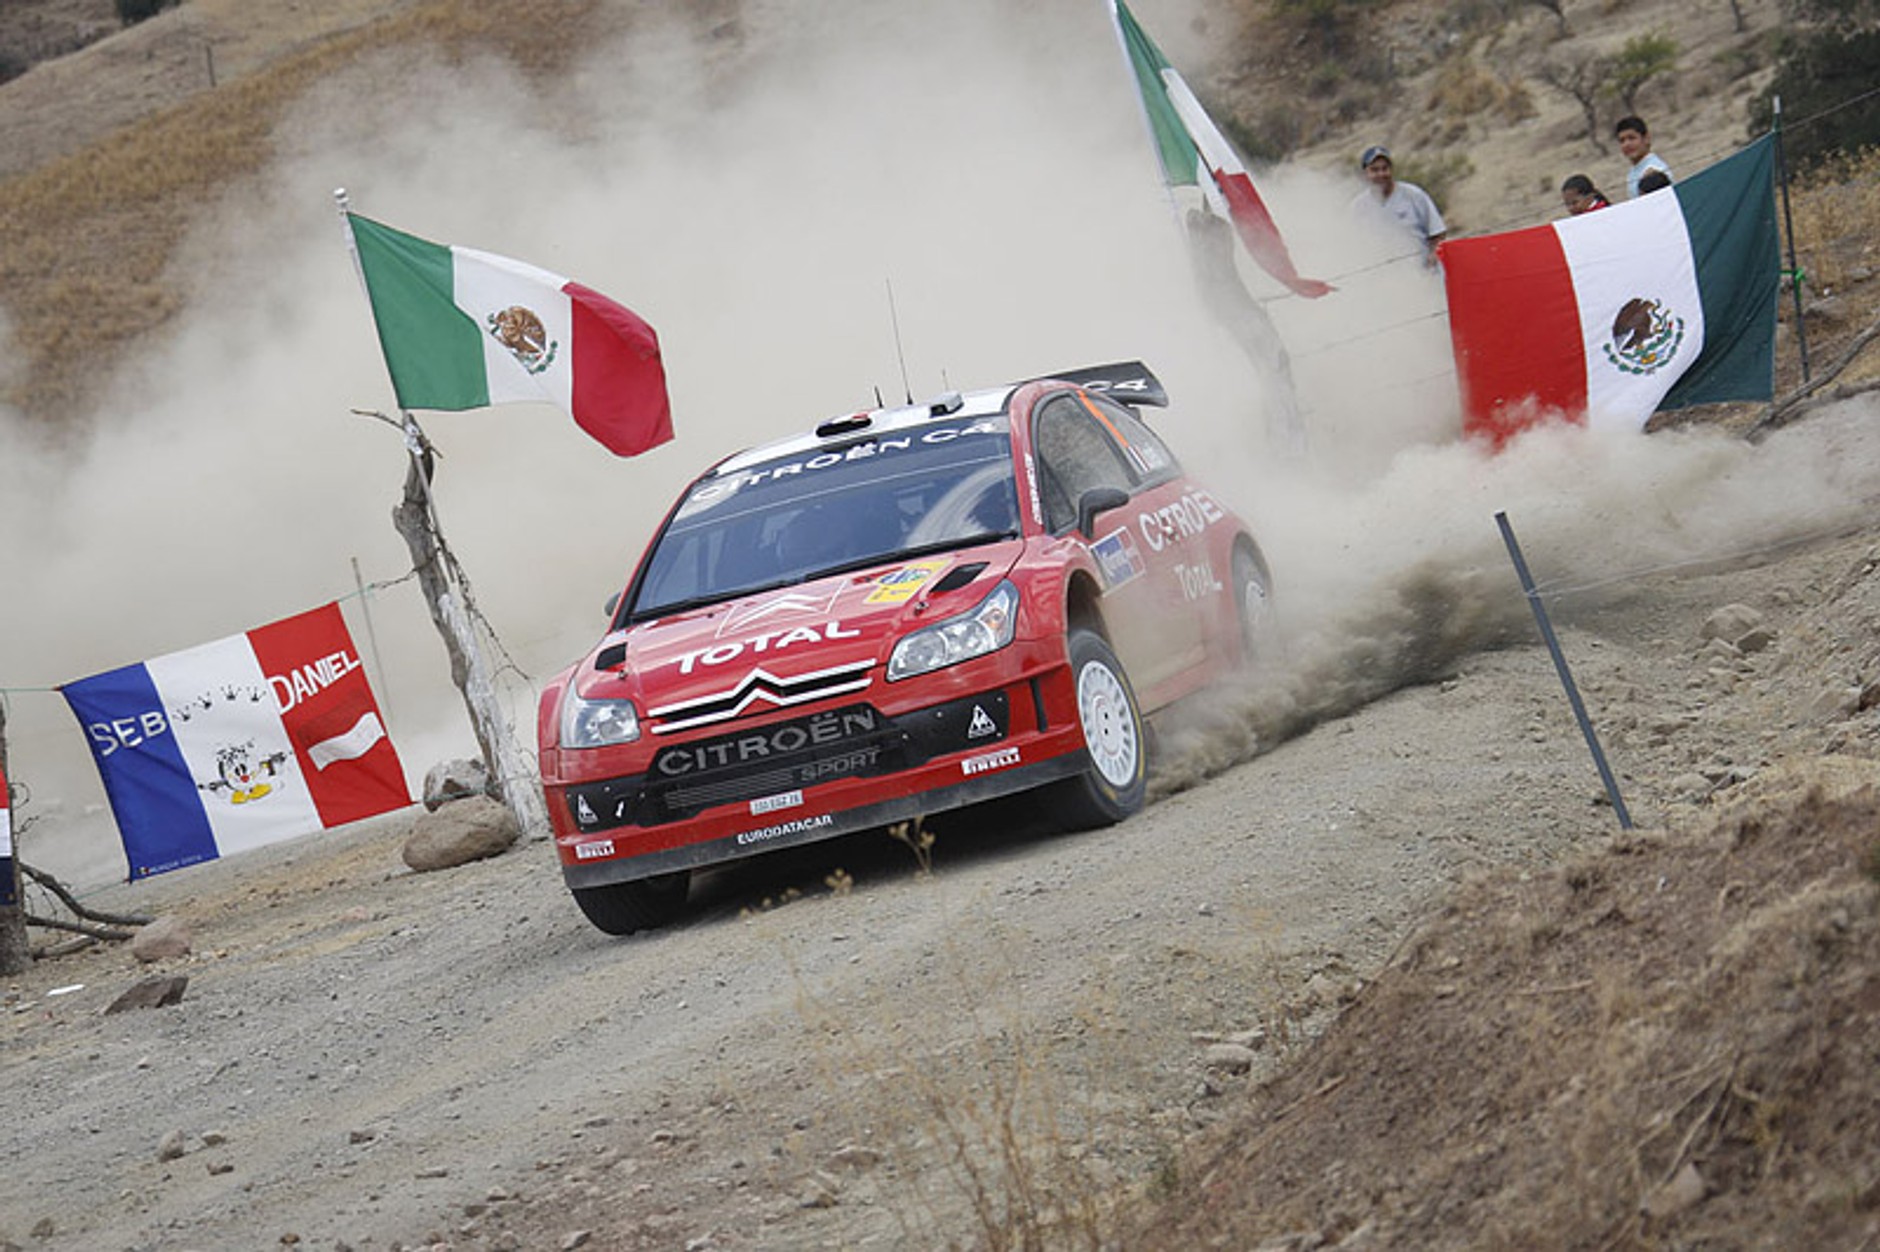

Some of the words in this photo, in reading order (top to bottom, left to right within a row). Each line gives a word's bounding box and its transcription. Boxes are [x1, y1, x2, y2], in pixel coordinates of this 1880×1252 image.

[1082, 378, 1148, 392] C4
[921, 422, 997, 444] C4
[674, 621, 860, 674] TOTAL
[266, 650, 361, 715] DANIEL
[88, 710, 169, 757] SEB
[657, 709, 877, 775] CITROËN
[800, 747, 881, 783] SPORT
[737, 814, 833, 845] EURODATACAR
